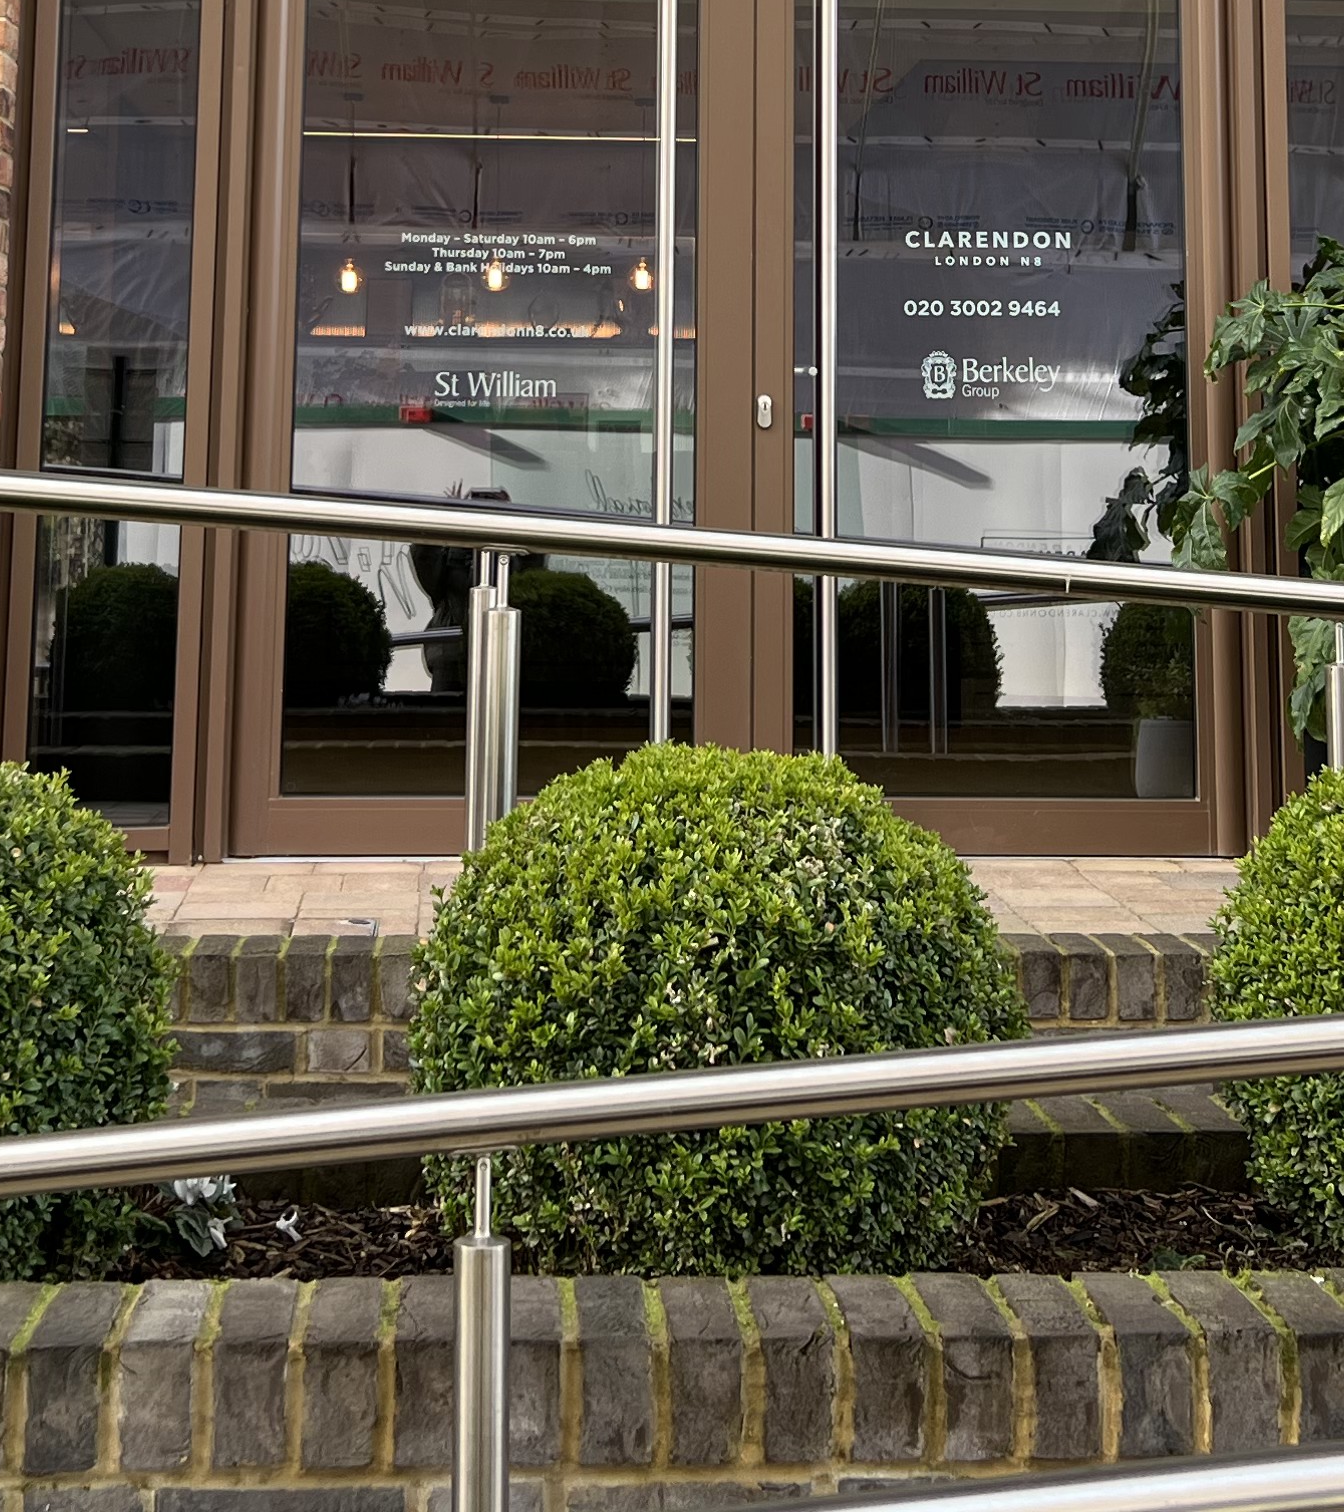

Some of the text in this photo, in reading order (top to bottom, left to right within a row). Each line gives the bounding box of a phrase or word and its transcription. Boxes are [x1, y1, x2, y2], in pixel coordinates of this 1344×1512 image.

[401, 232, 451, 246] Monday
[463, 233, 519, 246] Saturday
[522, 234, 556, 245] 10am
[568, 235, 597, 247] 6pm
[905, 231, 1071, 249] CLARENDON
[432, 247, 489, 261] Thursday
[492, 248, 526, 260] 10am
[538, 249, 566, 261] 7pm
[935, 256, 1042, 267] LONDON N8
[384, 261, 431, 275] Sunday
[434, 261, 444, 273] &
[446, 261, 478, 273] Bank
[537, 263, 571, 275] 10am
[582, 264, 612, 276] 4pm
[904, 300, 1061, 317] 020 3002 9464
[962, 356, 1061, 392] Berkeley
[435, 370, 556, 397] St William
[962, 384, 1000, 399] Group
